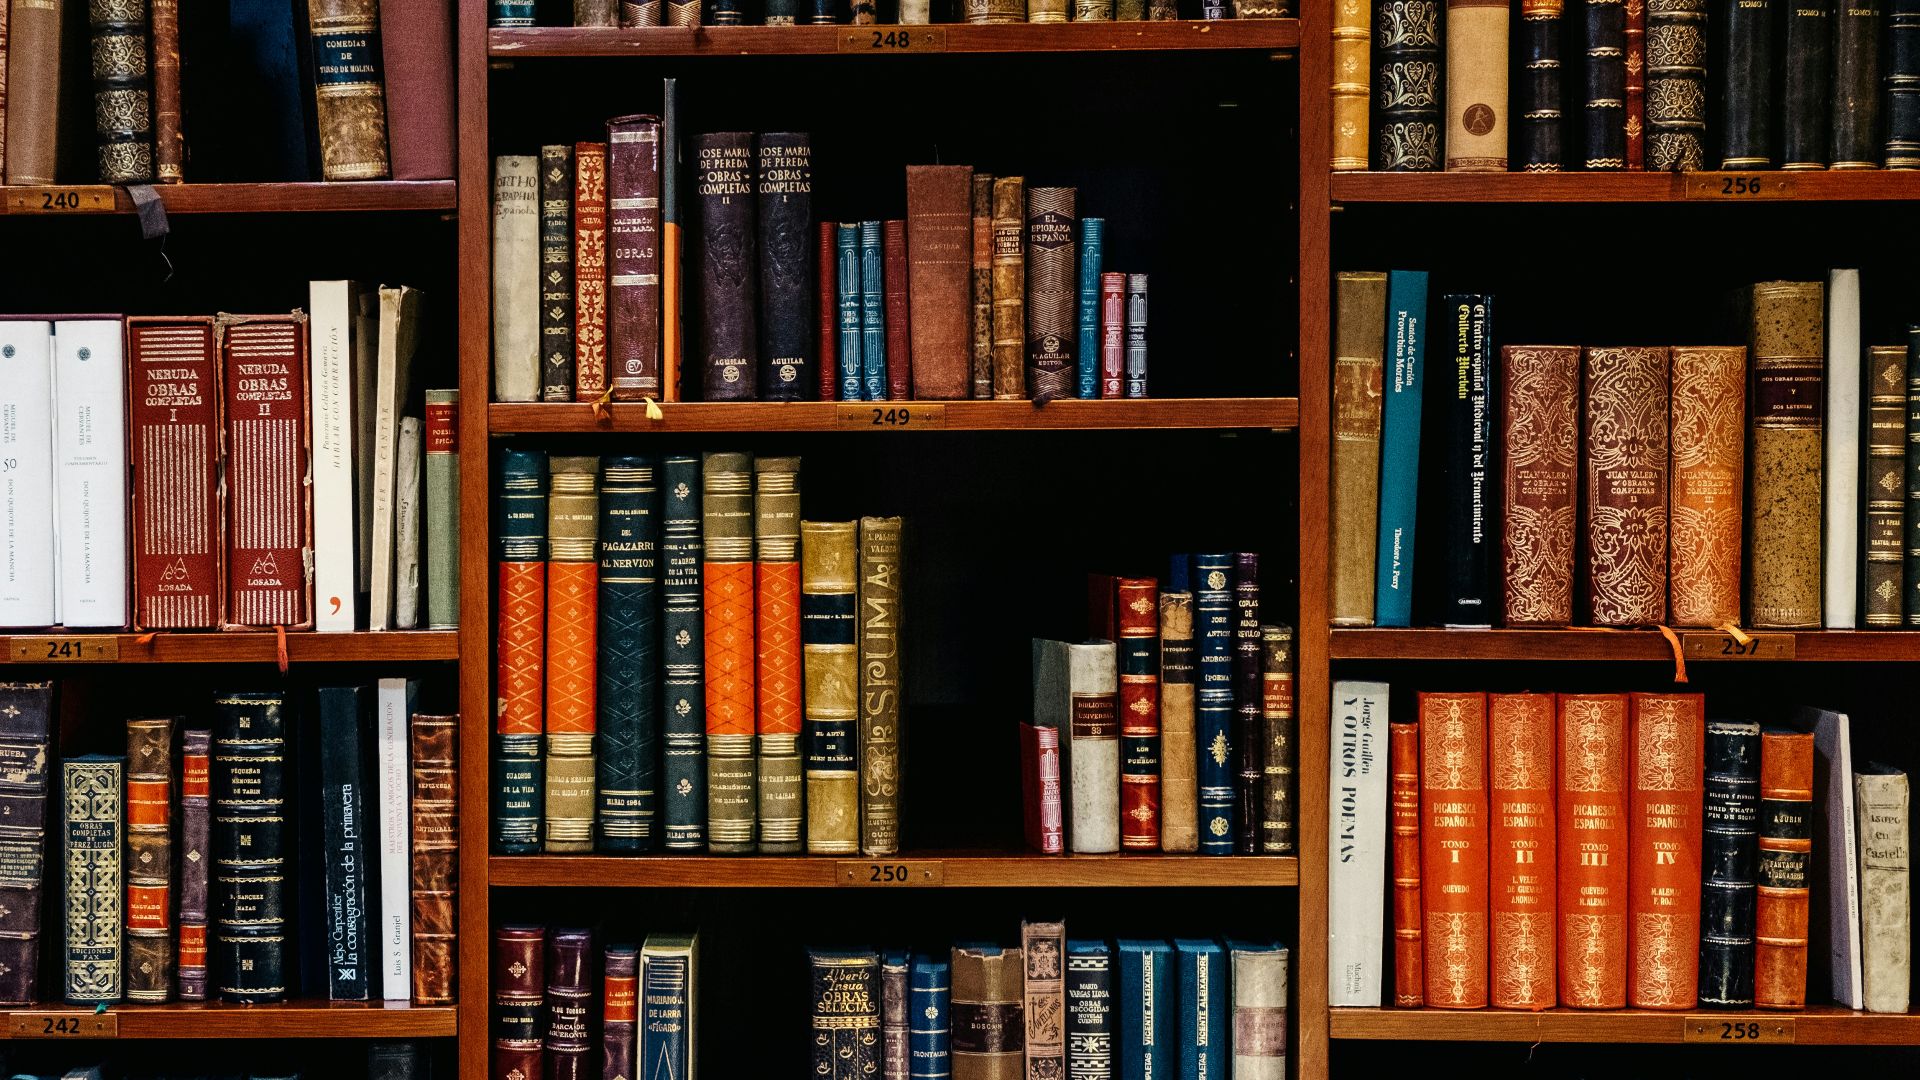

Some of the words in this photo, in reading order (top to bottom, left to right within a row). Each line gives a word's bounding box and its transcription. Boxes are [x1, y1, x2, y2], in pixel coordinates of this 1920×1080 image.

[325, 40, 367, 48] COMEDIAS
[871, 31, 910, 48] 248
[698, 148, 722, 158] JOSE
[724, 148, 751, 158] MARIA
[759, 147, 782, 157] JOSE
[785, 147, 811, 156] MARIA
[701, 160, 711, 169] DE
[714, 159, 748, 169] PEREDA
[761, 158, 772, 168] DE
[775, 158, 809, 167] PEREDA
[707, 171, 741, 182] OBRAS
[768, 170, 802, 181] OBRAS
[699, 183, 750, 195] COMPLETAS
[759, 182, 811, 193] COMPLETAS
[1722, 177, 1761, 194] 256
[42, 192, 80, 209] 240
[1045, 215, 1057, 223] EL
[1031, 224, 1072, 232] EPIGRAMA
[1031, 231, 1070, 242] ESPAÑOL
[616, 248, 654, 259] OBRAS
[1473, 304, 1484, 317] El
[1395, 310, 1407, 357] Proverbios
[1407, 318, 1417, 345] Santob
[1457, 304, 1471, 353] Edilberto
[1473, 320, 1484, 350] teatro
[715, 358, 747, 366] AGUILAR
[147, 369, 199, 380] NERUDA
[238, 363, 290, 375] NERUDA
[1394, 357, 1405, 393] Morales
[1406, 356, 1416, 386] Carrión
[1471, 352, 1484, 391] español
[1455, 356, 1470, 400] Marbán
[147, 383, 198, 397] OBRAS
[239, 378, 288, 391] OBRAS
[145, 396, 203, 406] COMPLETAS
[236, 391, 293, 401] COMPLETAS
[170, 408, 177, 422] I
[258, 403, 271, 416] II
[331, 398, 340, 421] CON
[872, 408, 910, 425] 249
[1471, 394, 1485, 443] Medieval
[380, 407, 391, 460] CANTAR
[1472, 454, 1484, 468] del
[1518, 471, 1541, 479] JUAN
[1543, 472, 1571, 480] VALERA
[1606, 472, 1628, 480] JUAN
[1470, 471, 1485, 543] Renacimiento
[602, 542, 654, 551] PAGAZARRI
[1393, 528, 1403, 560] Theodore
[613, 559, 654, 568] NERVION
[1393, 561, 1402, 570] A.
[158, 584, 194, 592] LOSADA
[48, 641, 82, 658] 241
[1722, 638, 1760, 656] 257
[1360, 697, 1375, 733] Jorge
[1342, 715, 1358, 780] OTROS
[1360, 736, 1373, 776] Guillén
[4, 805, 10, 815] 2
[341, 784, 358, 839] primavera
[1433, 803, 1476, 814] PICARESCA
[1503, 803, 1545, 814] PICARESCA
[1574, 805, 1616, 816] PICARESCA
[1646, 804, 1688, 814] PICARESCA
[1340, 787, 1357, 864] POEMAS
[1434, 816, 1475, 827] ESPAÑOLA
[1504, 816, 1544, 827] ESPAÑOLA
[1575, 818, 1615, 829] ESPAÑOLA
[1647, 817, 1687, 828] ESPAÑOLA
[1441, 841, 1469, 849] TOMO
[1510, 841, 1539, 849] TOMO
[1581, 843, 1609, 851] TOMO
[1653, 842, 1681, 850] TOMO
[1451, 850, 1459, 864] I
[1516, 850, 1534, 864] II
[1581, 853, 1608, 866] III
[1656, 851, 1678, 865] IV
[341, 854, 355, 873] de
[870, 865, 908, 882] 250
[1519, 876, 1538, 884] VELEZ
[1442, 885, 1470, 894] QUEVEDO
[1581, 887, 1609, 895] QUEVEDO
[333, 893, 343, 940] Carpentier
[342, 875, 361, 950] consagración
[392, 915, 402, 945] Granjel
[333, 942, 346, 965] Alejo
[345, 952, 358, 966] La
[393, 960, 402, 976] Luis
[823, 969, 870, 980] Alberto
[1199, 955, 1207, 1006] ALEIXANDRE
[828, 980, 864, 991] Insua
[647, 995, 677, 1005] MARIANO
[822, 991, 868, 1002] OBRAS
[1069, 990, 1091, 998] VARGAS
[1092, 990, 1110, 998] LLOSA
[659, 1009, 682, 1018] LARRA
[817, 1002, 876, 1013] SELECTAS
[43, 1017, 80, 1034] 242
[1199, 1011, 1207, 1046] VICENTE
[1721, 1023, 1760, 1039] 258
